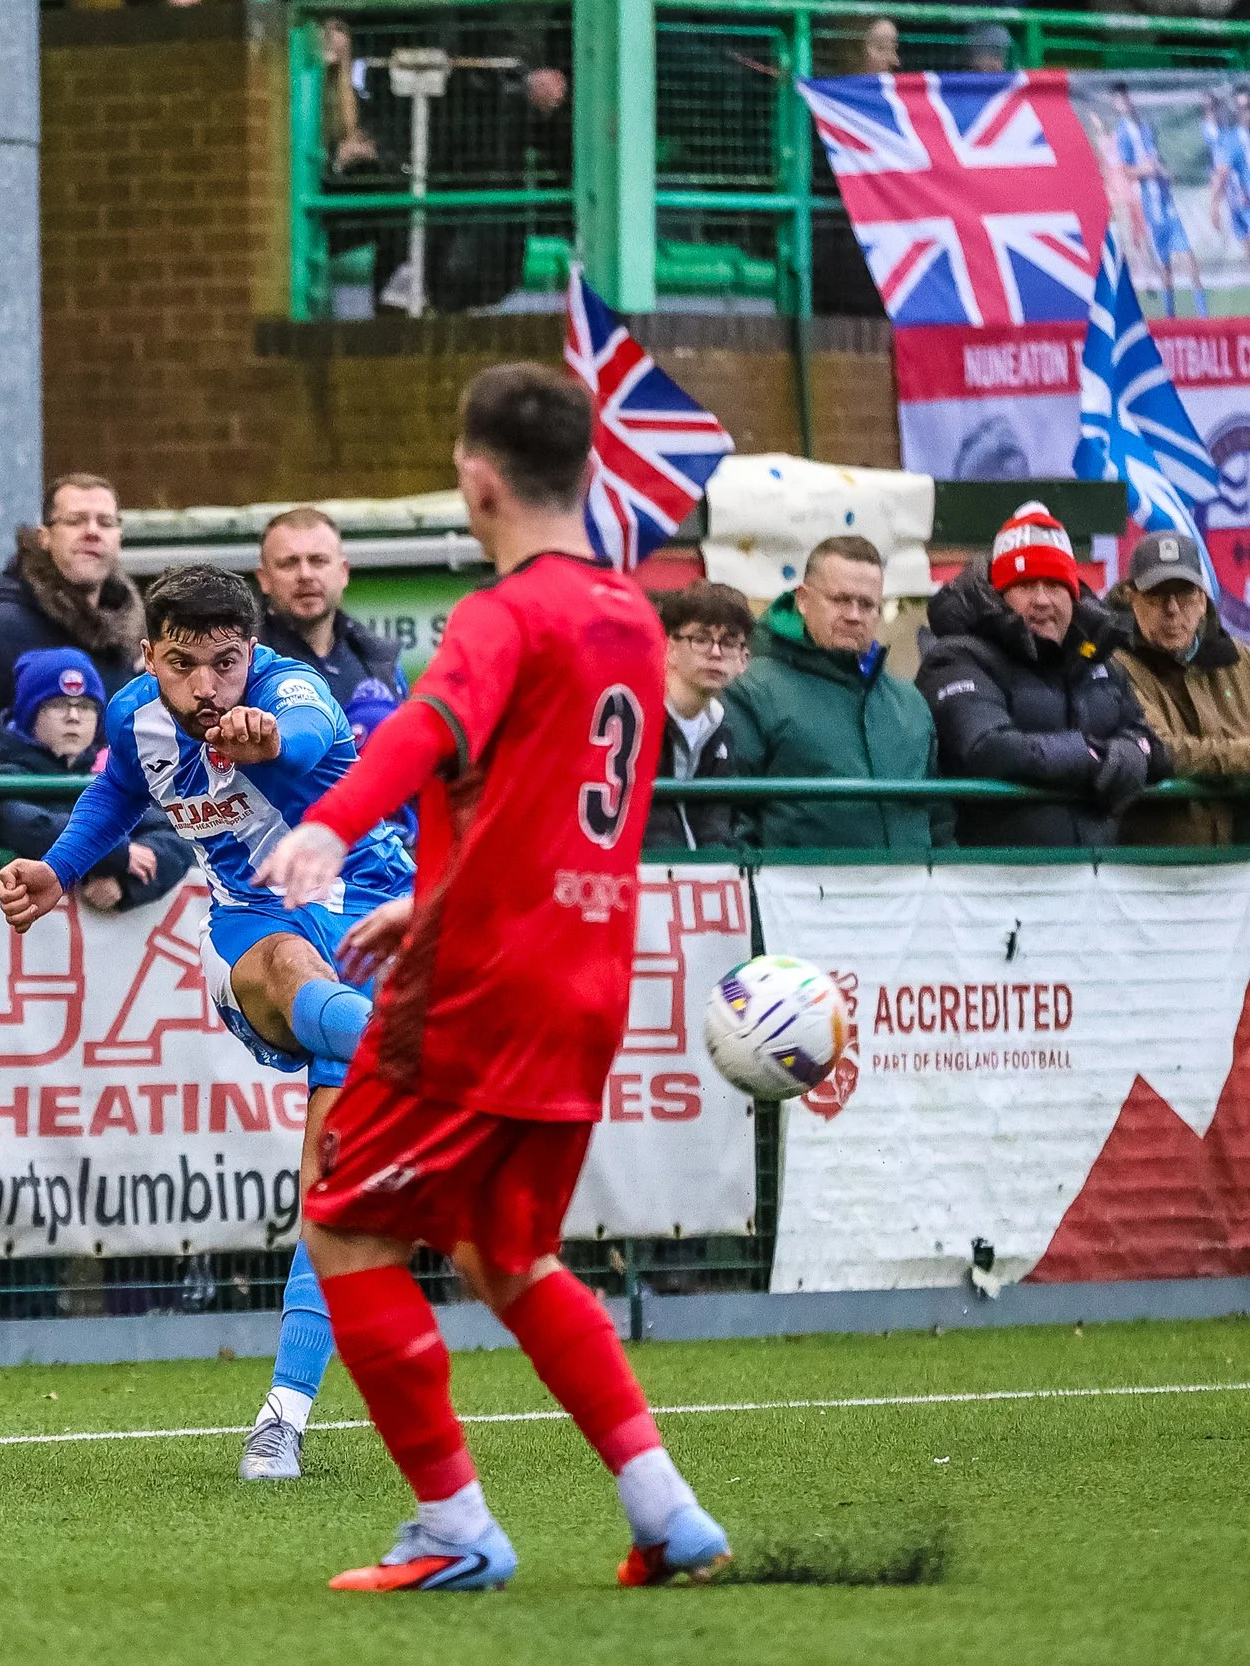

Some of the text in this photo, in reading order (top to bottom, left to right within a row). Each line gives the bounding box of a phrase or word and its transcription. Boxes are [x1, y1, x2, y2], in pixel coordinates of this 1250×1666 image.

[578, 682, 645, 850] 3
[873, 982, 1074, 1035] ACCREDITED
[872, 1048, 1072, 1074] PART OF ENGLAND FOOTBALL
